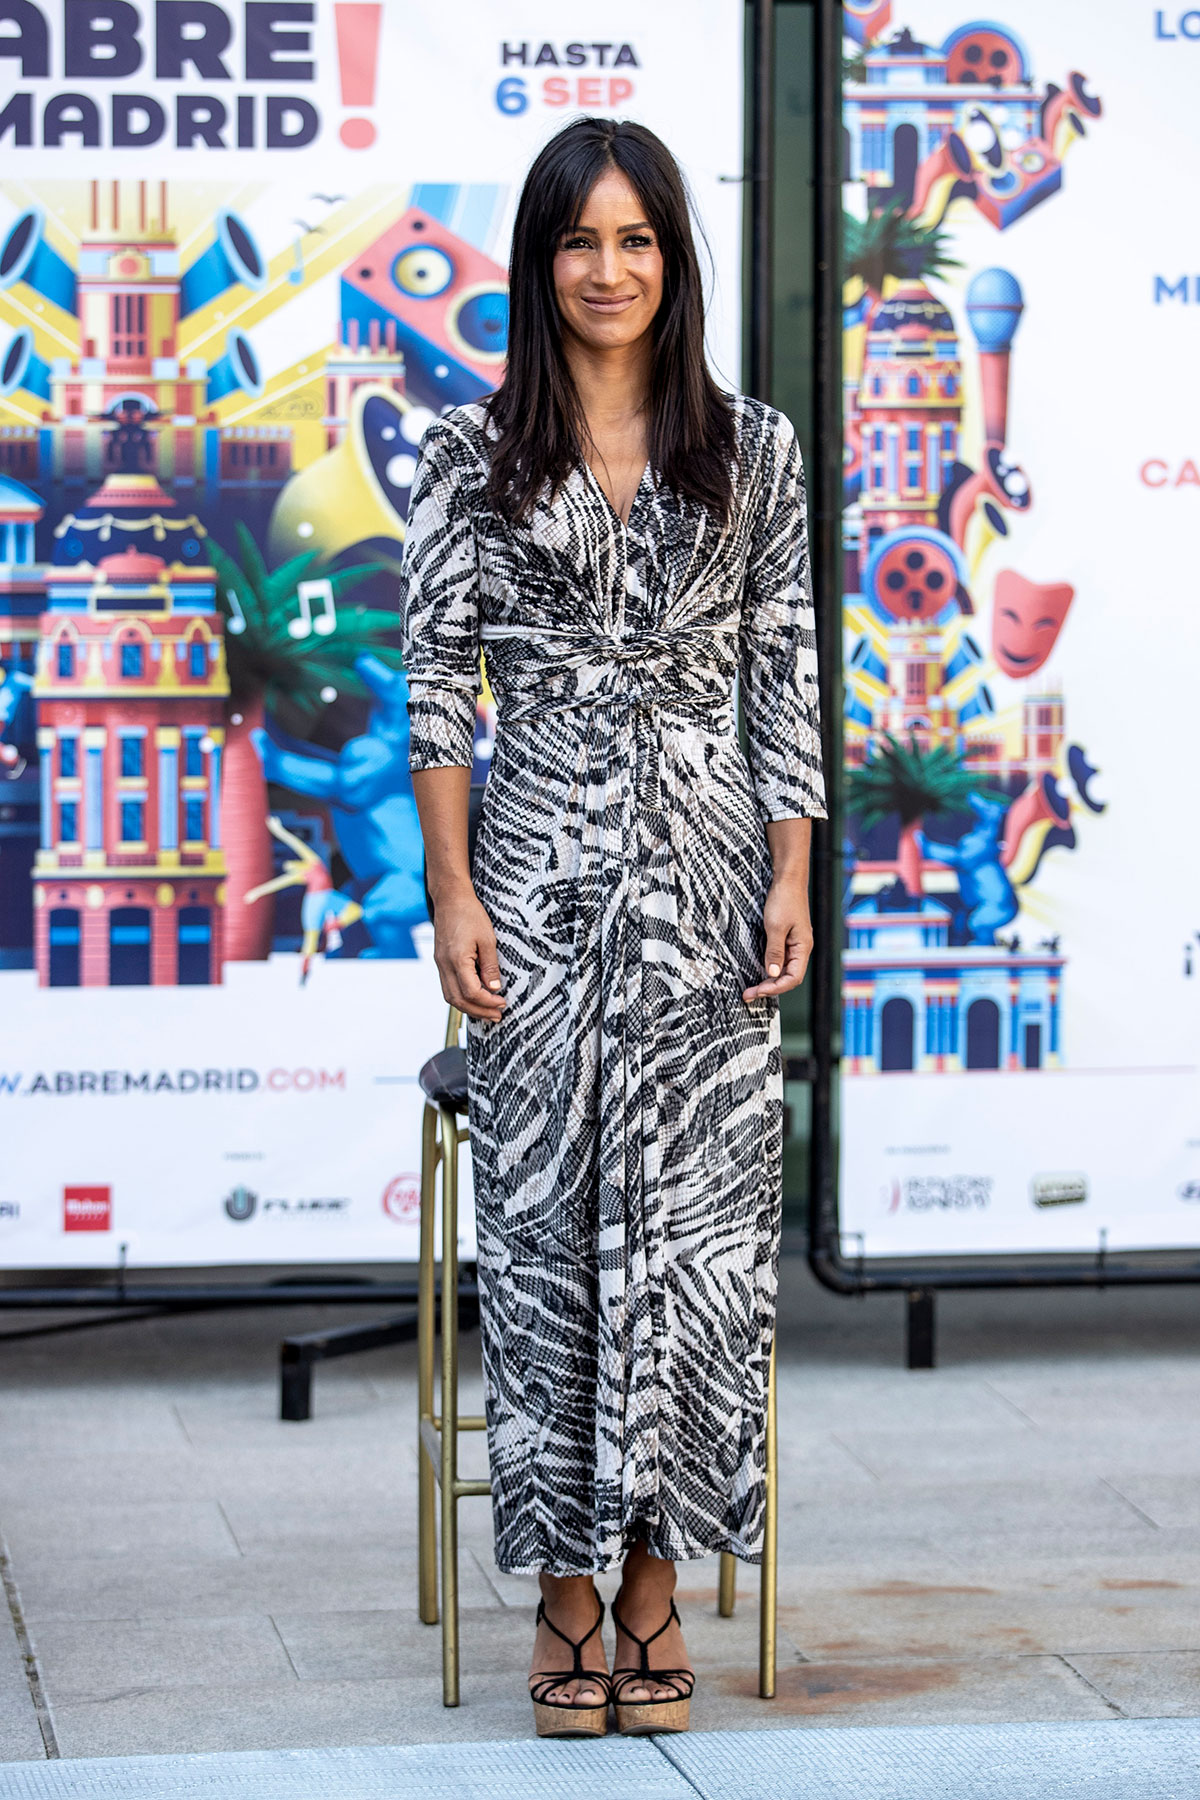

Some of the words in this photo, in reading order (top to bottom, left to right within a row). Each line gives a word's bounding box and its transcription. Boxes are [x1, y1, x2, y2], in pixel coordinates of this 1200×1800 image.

[0, 0, 316, 81] ABRE
[501, 41, 640, 68] HASTA
[495, 76, 529, 117] 6
[543, 77, 633, 107] SEP
